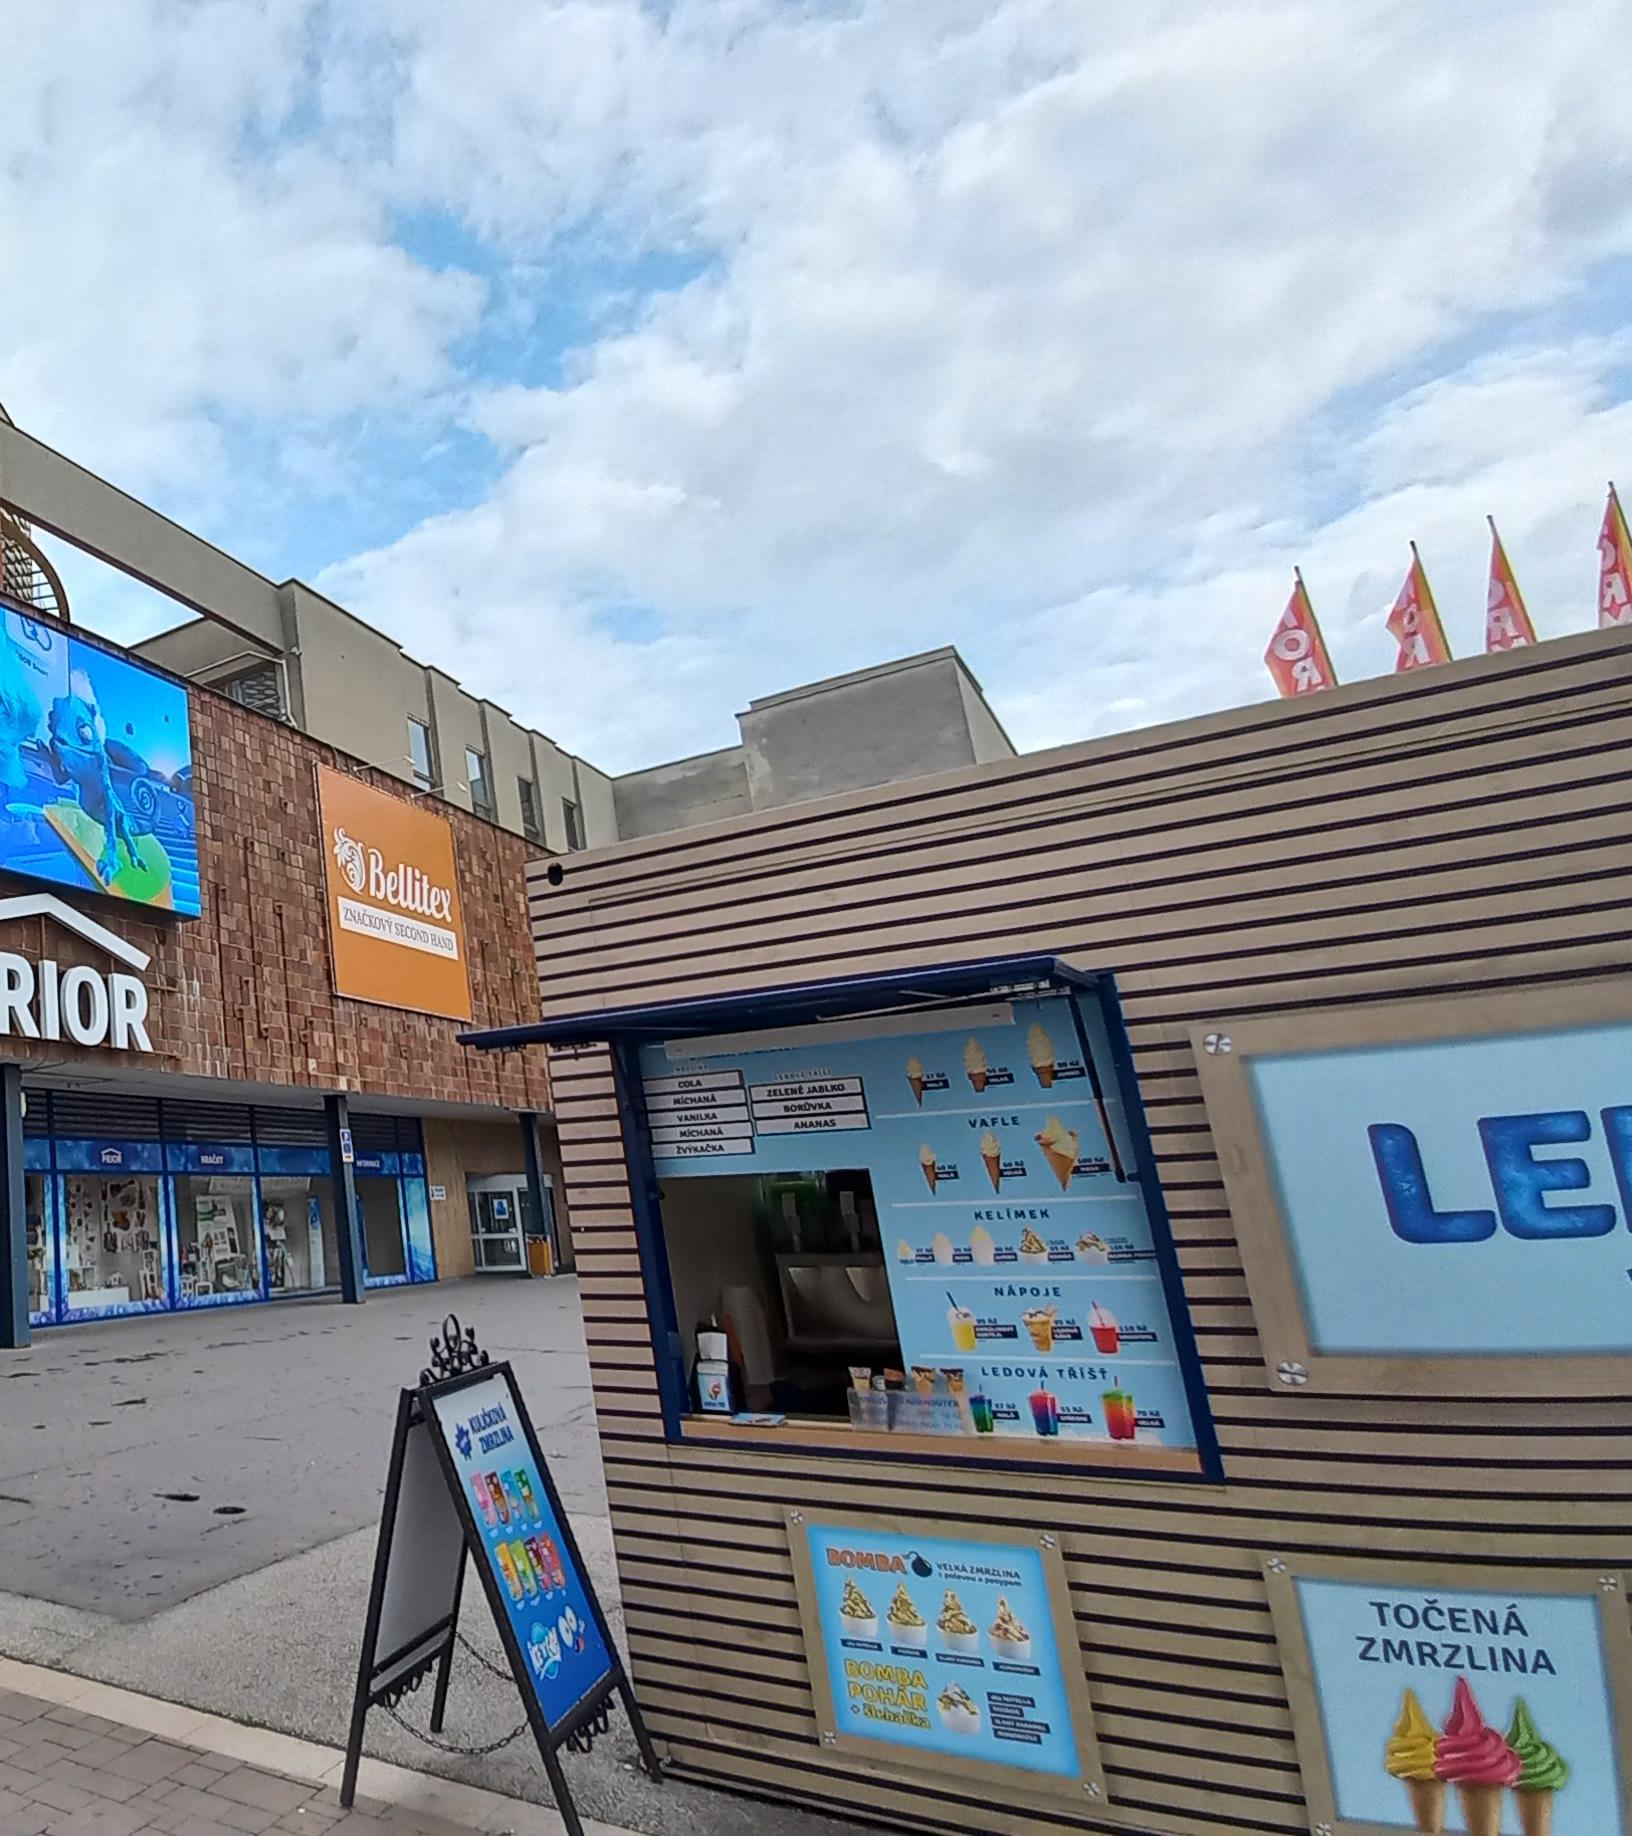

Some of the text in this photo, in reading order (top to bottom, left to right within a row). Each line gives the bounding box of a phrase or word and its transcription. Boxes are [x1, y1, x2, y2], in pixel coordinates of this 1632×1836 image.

[367, 847, 452, 922] Bellitex
[342, 905, 454, 952] ZNAČKOVÝ SECOND HAND
[677, 1078, 702, 1088] COLA
[766, 1083, 846, 1097] ZELENÉ JABLKO
[672, 1095, 717, 1106] MÍCHANÁ
[783, 1101, 832, 1113] BORŮVKA
[676, 1112, 718, 1122] VANILKA
[794, 1118, 837, 1129] ANANAS
[968, 1115, 1020, 1128] VAFLE
[679, 1127, 724, 1138] MÍCHANÁ
[675, 1143, 725, 1155] ŽVÝKAČKA
[1367, 1105, 1632, 1244] LE
[974, 1206, 1050, 1221] KELÍMEK
[994, 1284, 1062, 1297] NÁPOJE
[981, 1365, 1109, 1380] LEDOVÁ TŘÍŠŤ
[826, 1547, 908, 1575] BOMBA
[936, 1563, 1021, 1580] VELKÁ ZMRZLINA
[1369, 1598, 1529, 1637] TOČENÁ
[1356, 1636, 1557, 1676] ZMRZLINA
[844, 1658, 928, 1689] BOMBA
[847, 1680, 928, 1712] POHÁR
